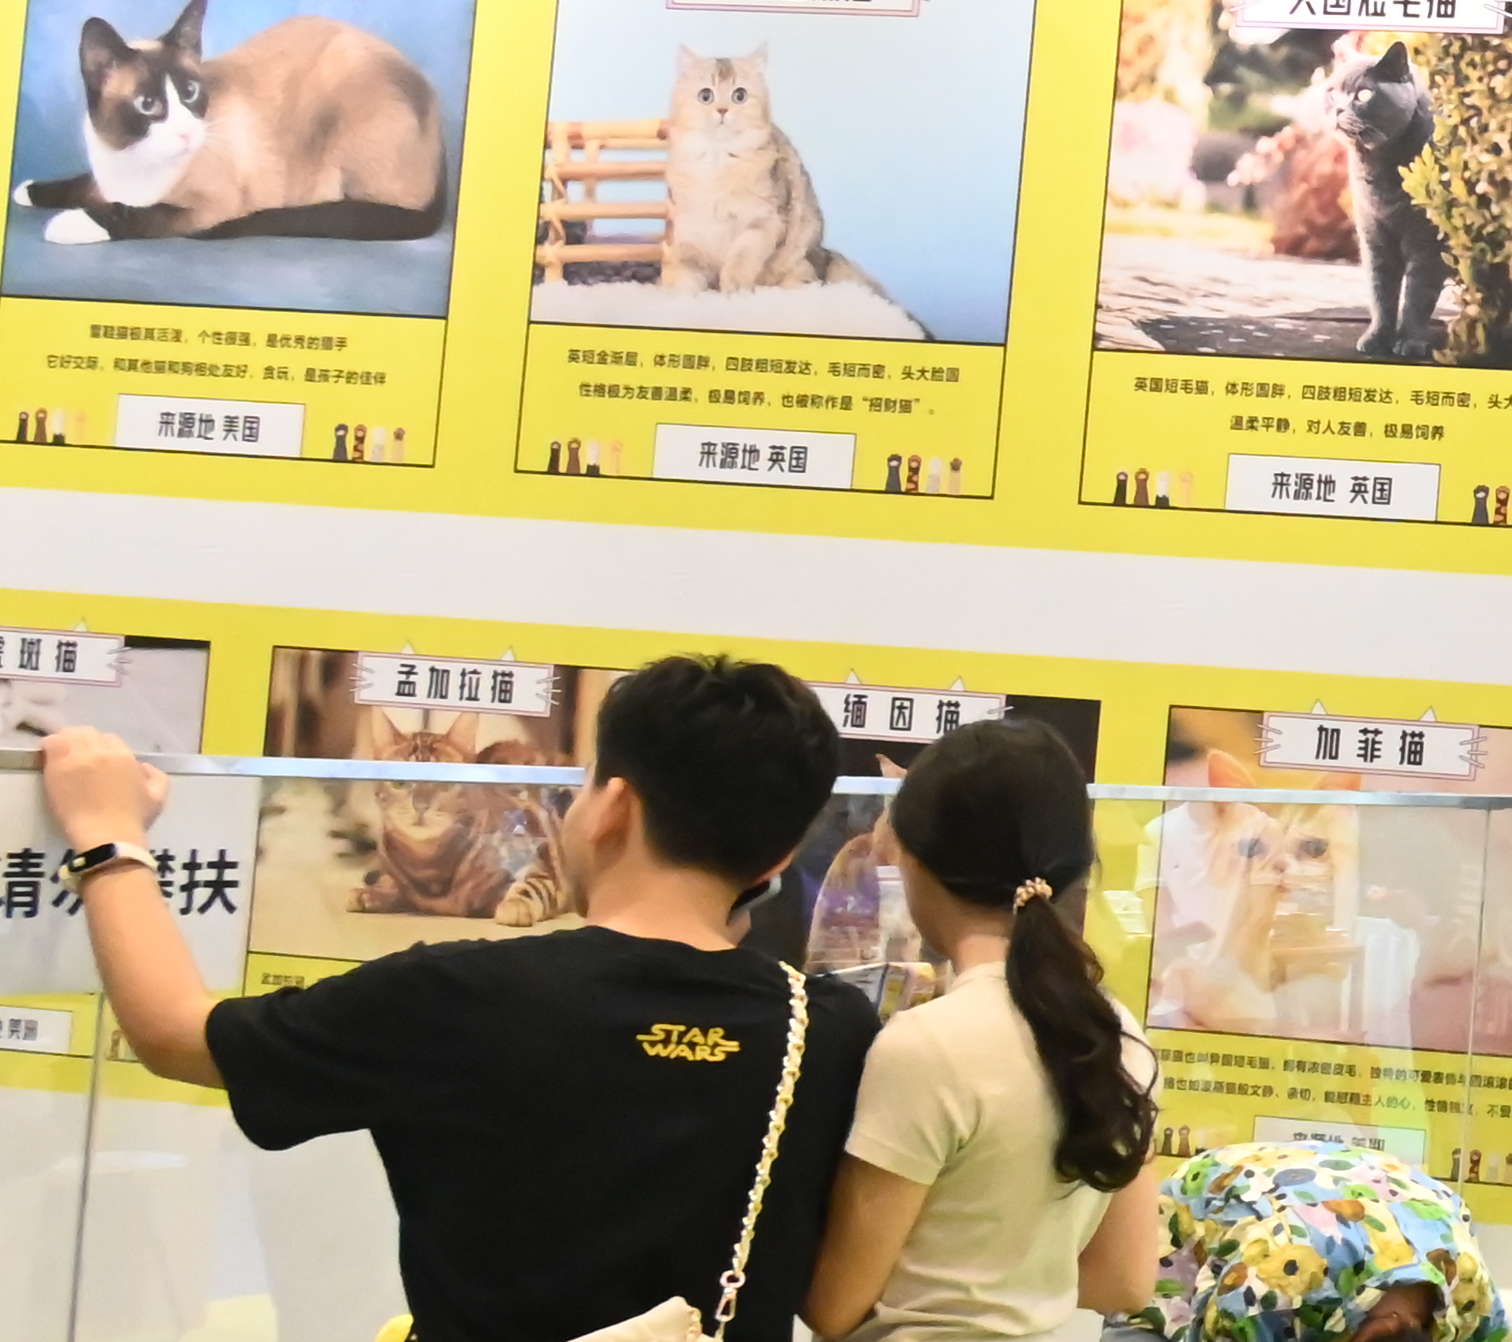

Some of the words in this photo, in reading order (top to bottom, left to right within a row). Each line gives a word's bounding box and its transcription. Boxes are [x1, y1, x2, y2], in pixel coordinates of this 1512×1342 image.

[157, 411, 215, 441] 来源地
[221, 413, 260, 444] 美国
[698, 441, 761, 471] 来源地
[766, 445, 808, 474] 英国
[1270, 471, 1337, 503] 来源地
[1348, 476, 1393, 506] 英国
[394, 663, 516, 705] 孟加拉猫
[841, 694, 961, 735] 缅因猫
[1315, 724, 1427, 766] 加菲猫
[636, 1023, 741, 1046] STAR
[642, 1042, 741, 1062] WARS
